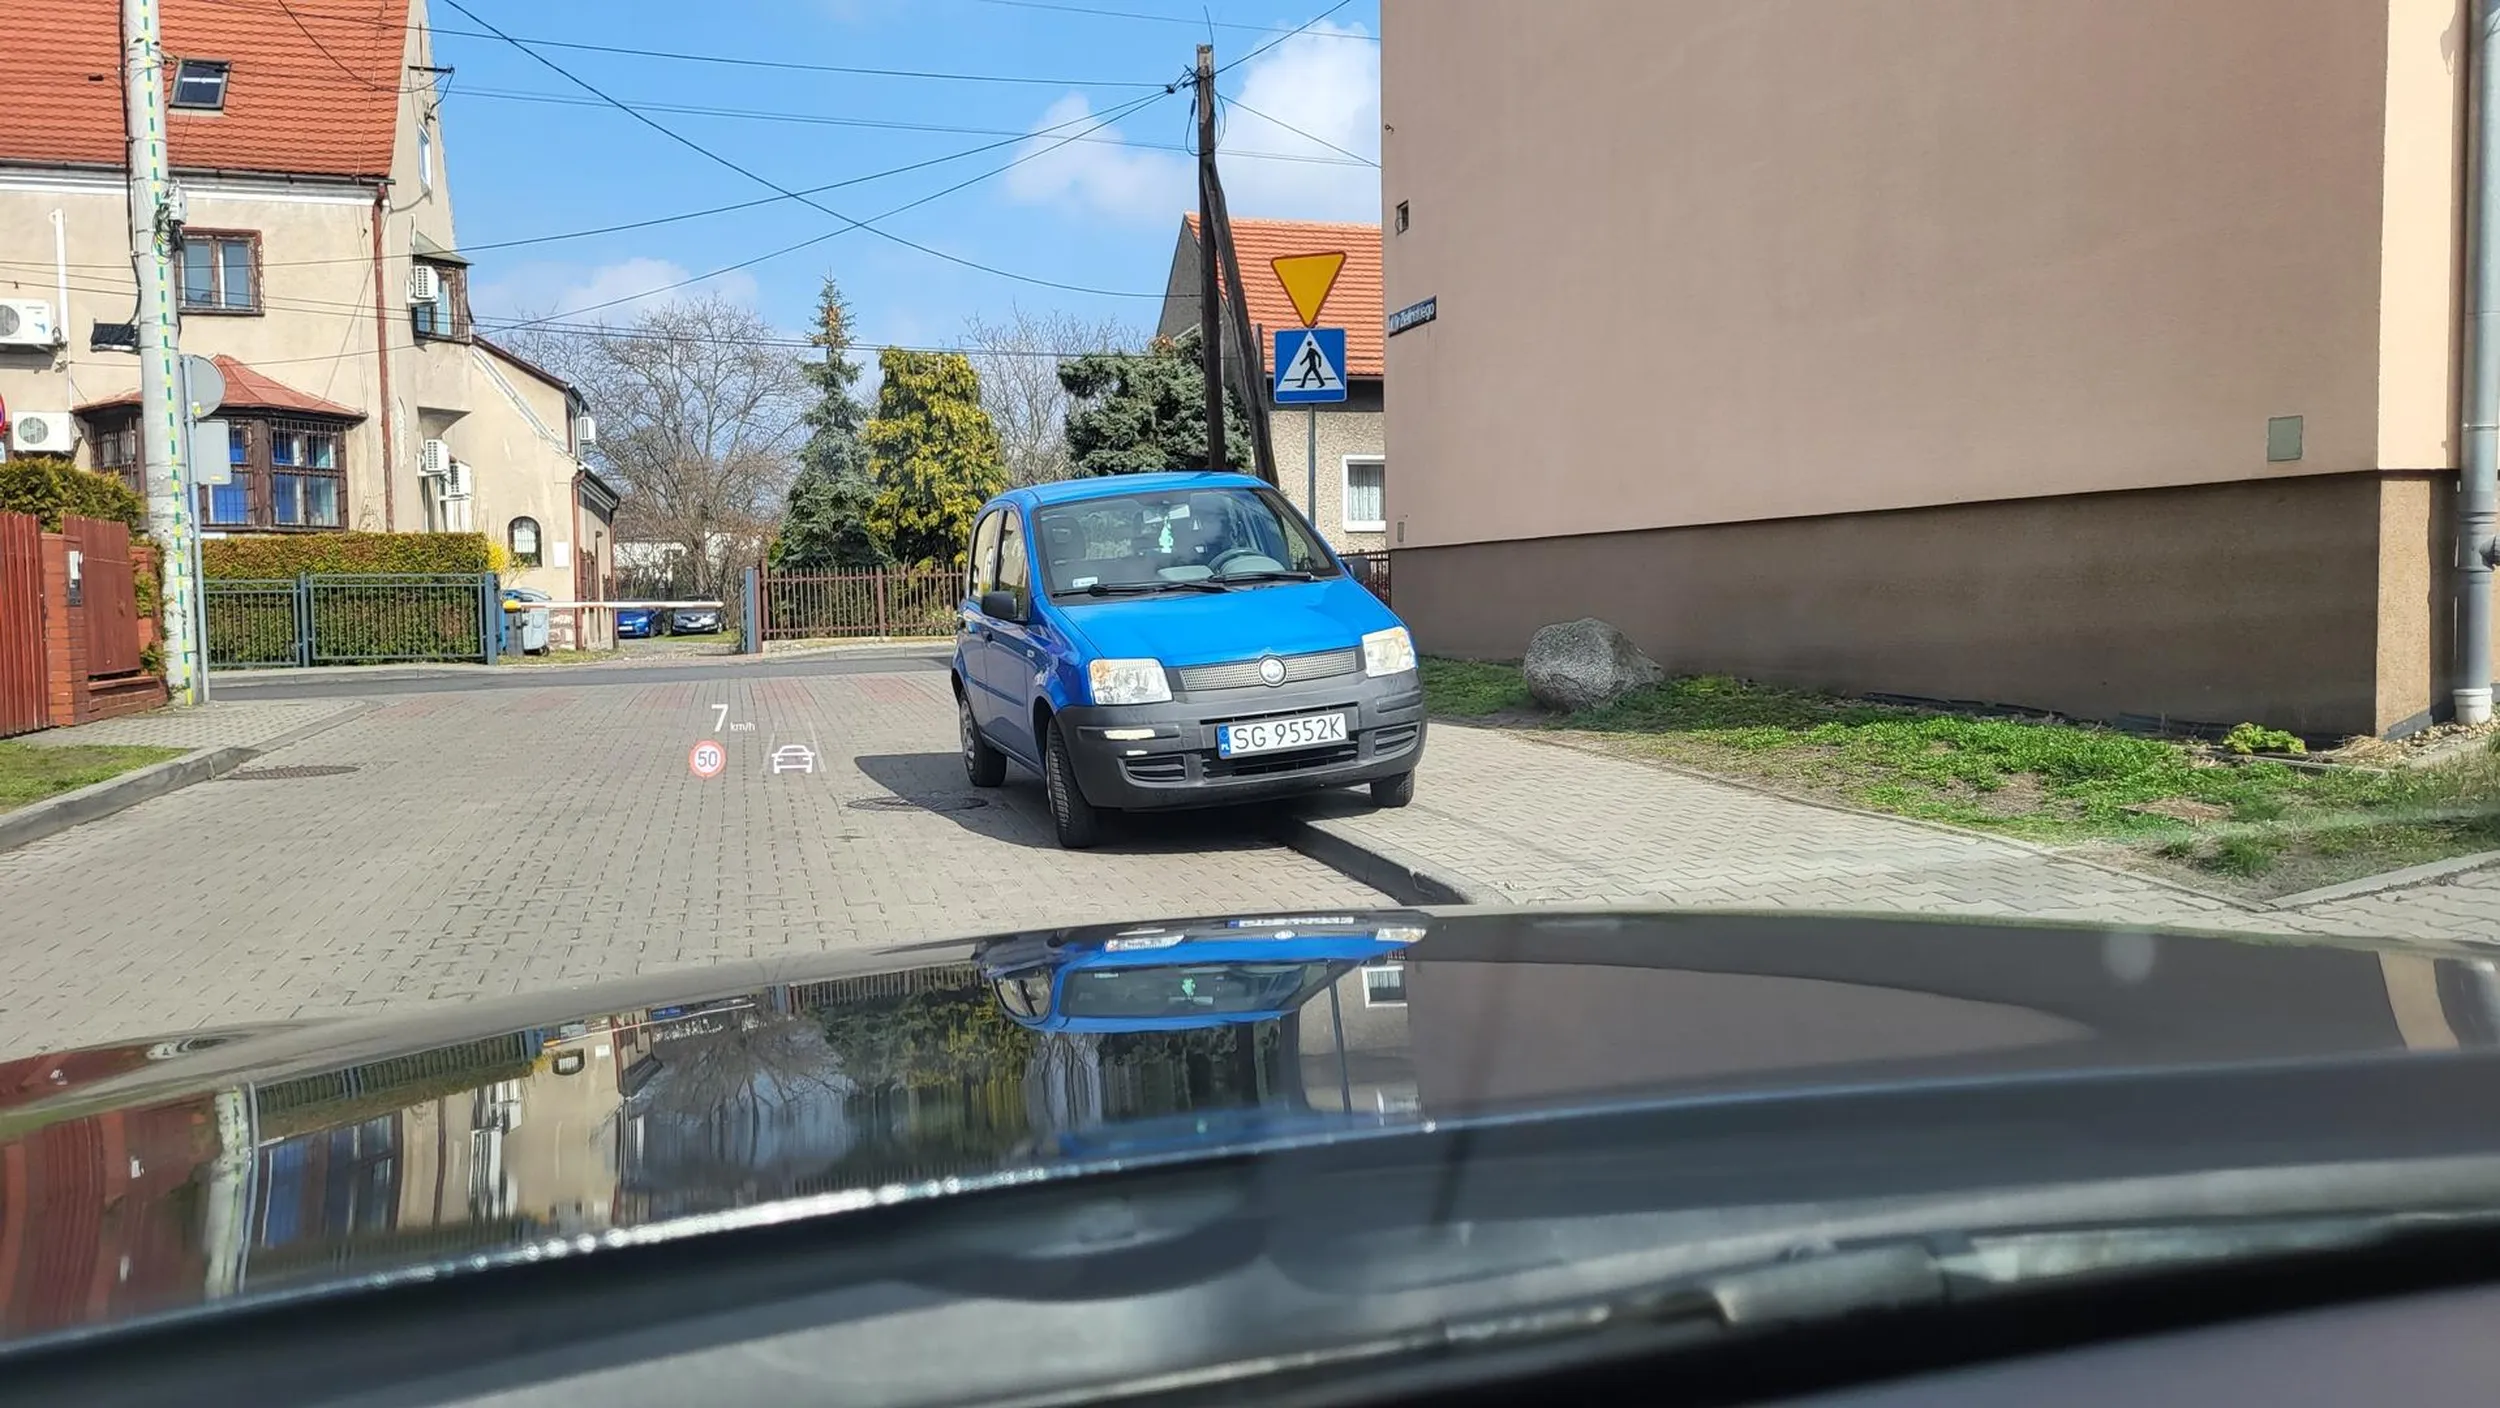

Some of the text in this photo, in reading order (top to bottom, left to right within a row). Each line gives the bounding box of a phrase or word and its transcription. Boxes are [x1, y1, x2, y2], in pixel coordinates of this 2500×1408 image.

[711, 703, 756, 732] 7 km/h
[1233, 716, 1342, 750] SG 9552K
[697, 750, 718, 768] 50
